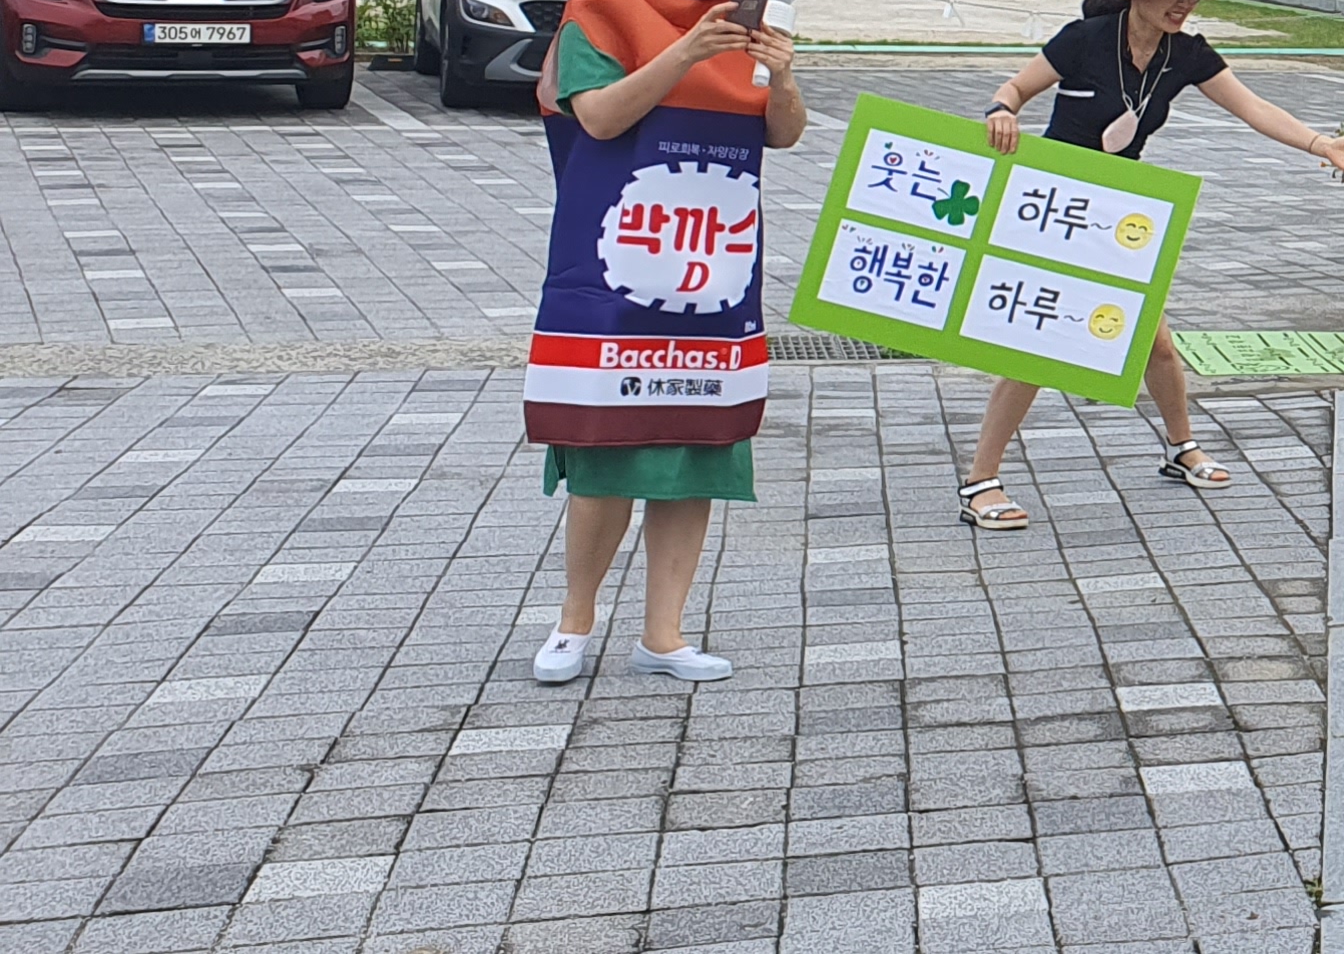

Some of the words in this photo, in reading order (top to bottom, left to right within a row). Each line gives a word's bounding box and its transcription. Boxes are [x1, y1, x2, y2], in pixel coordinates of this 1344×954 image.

[157, 26, 202, 41] 305어
[206, 26, 247, 41] 7967
[868, 150, 942, 203] 웃는
[616, 202, 756, 257] 박까스
[676, 261, 709, 292] D
[849, 244, 950, 309] 행복한
